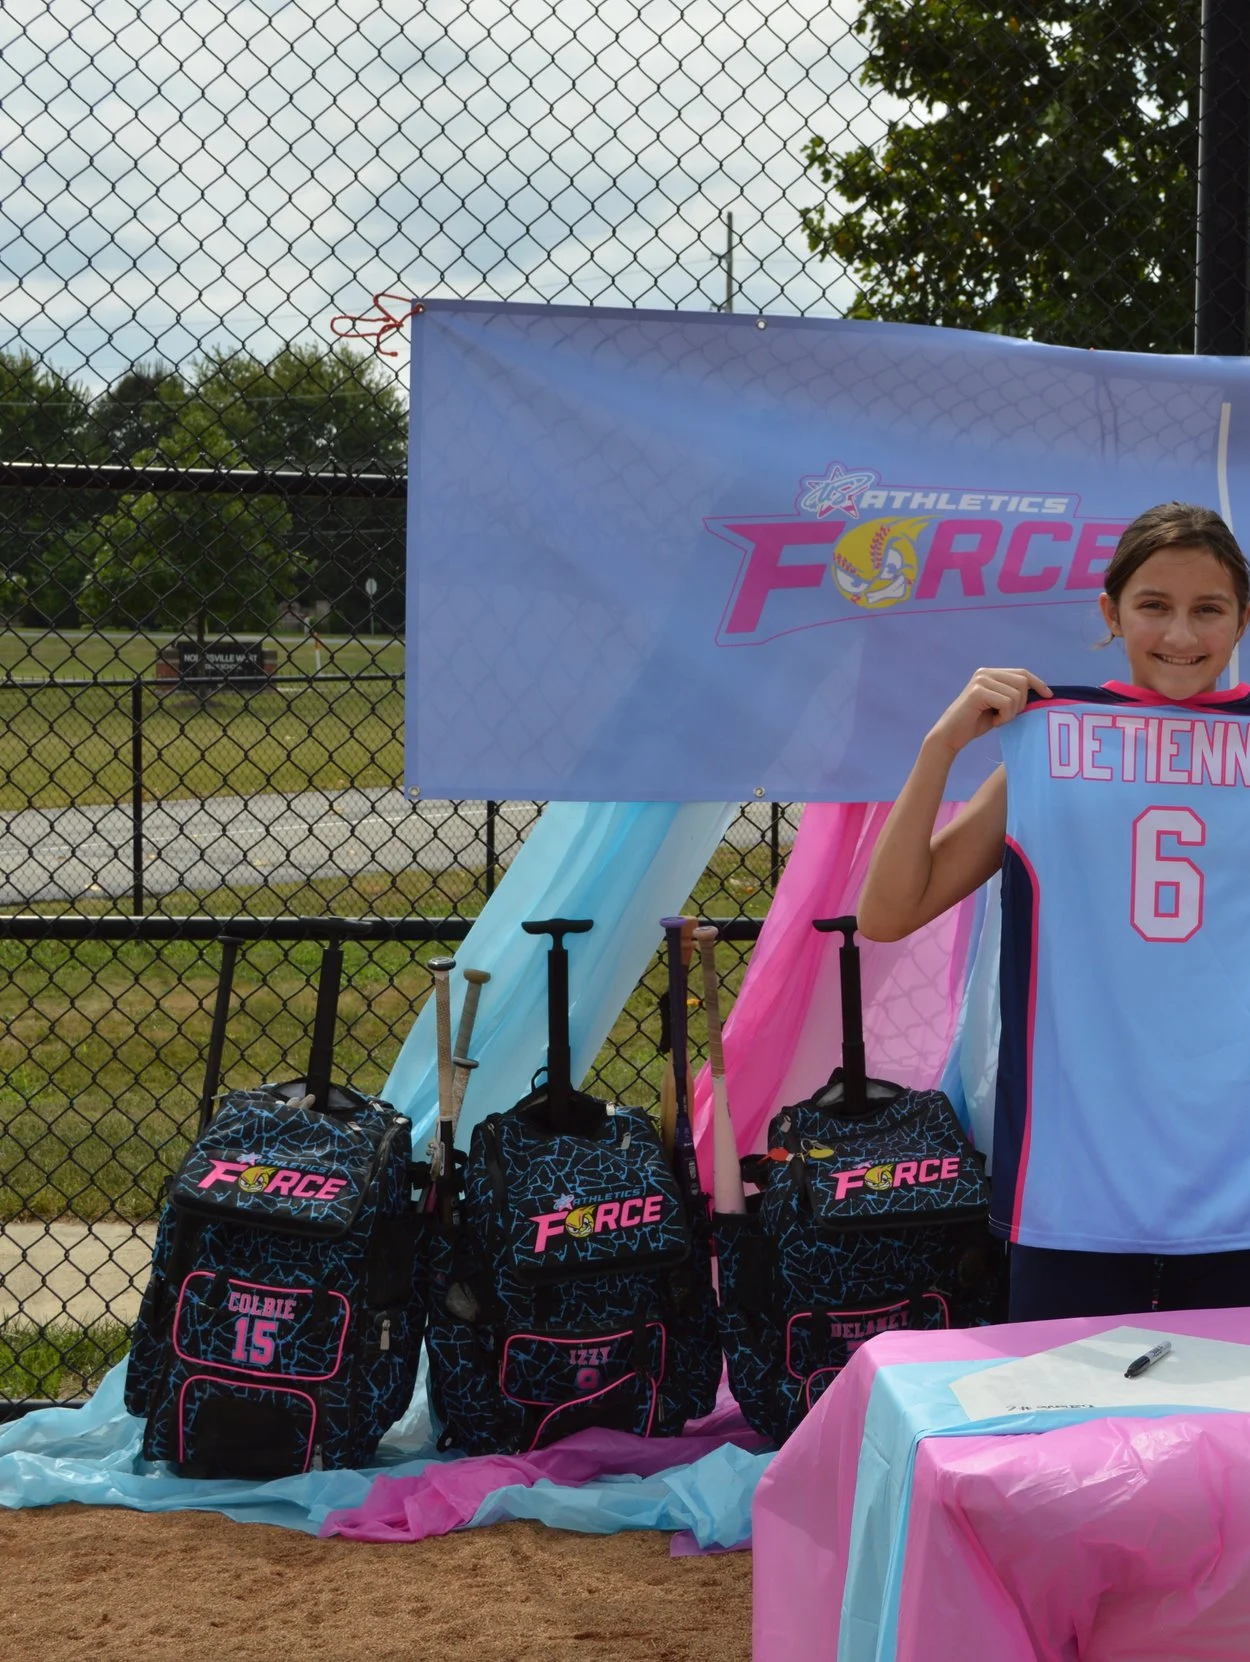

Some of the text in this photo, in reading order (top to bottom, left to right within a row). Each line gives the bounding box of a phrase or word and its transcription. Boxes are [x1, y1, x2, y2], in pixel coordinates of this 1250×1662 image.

[860, 490, 1069, 514] ATHLETICS
[1130, 805, 1206, 943] 6
[197, 1159, 348, 1200] FORCE
[255, 1158, 329, 1174] ATHLETICS
[831, 1157, 960, 1200] FORCE
[573, 1188, 641, 1205] ATHLETICS
[529, 1195, 663, 1253] FORCE
[228, 1291, 297, 1320] COLBIE
[232, 1317, 279, 1366] 15
[570, 1346, 611, 1365] IZZY
